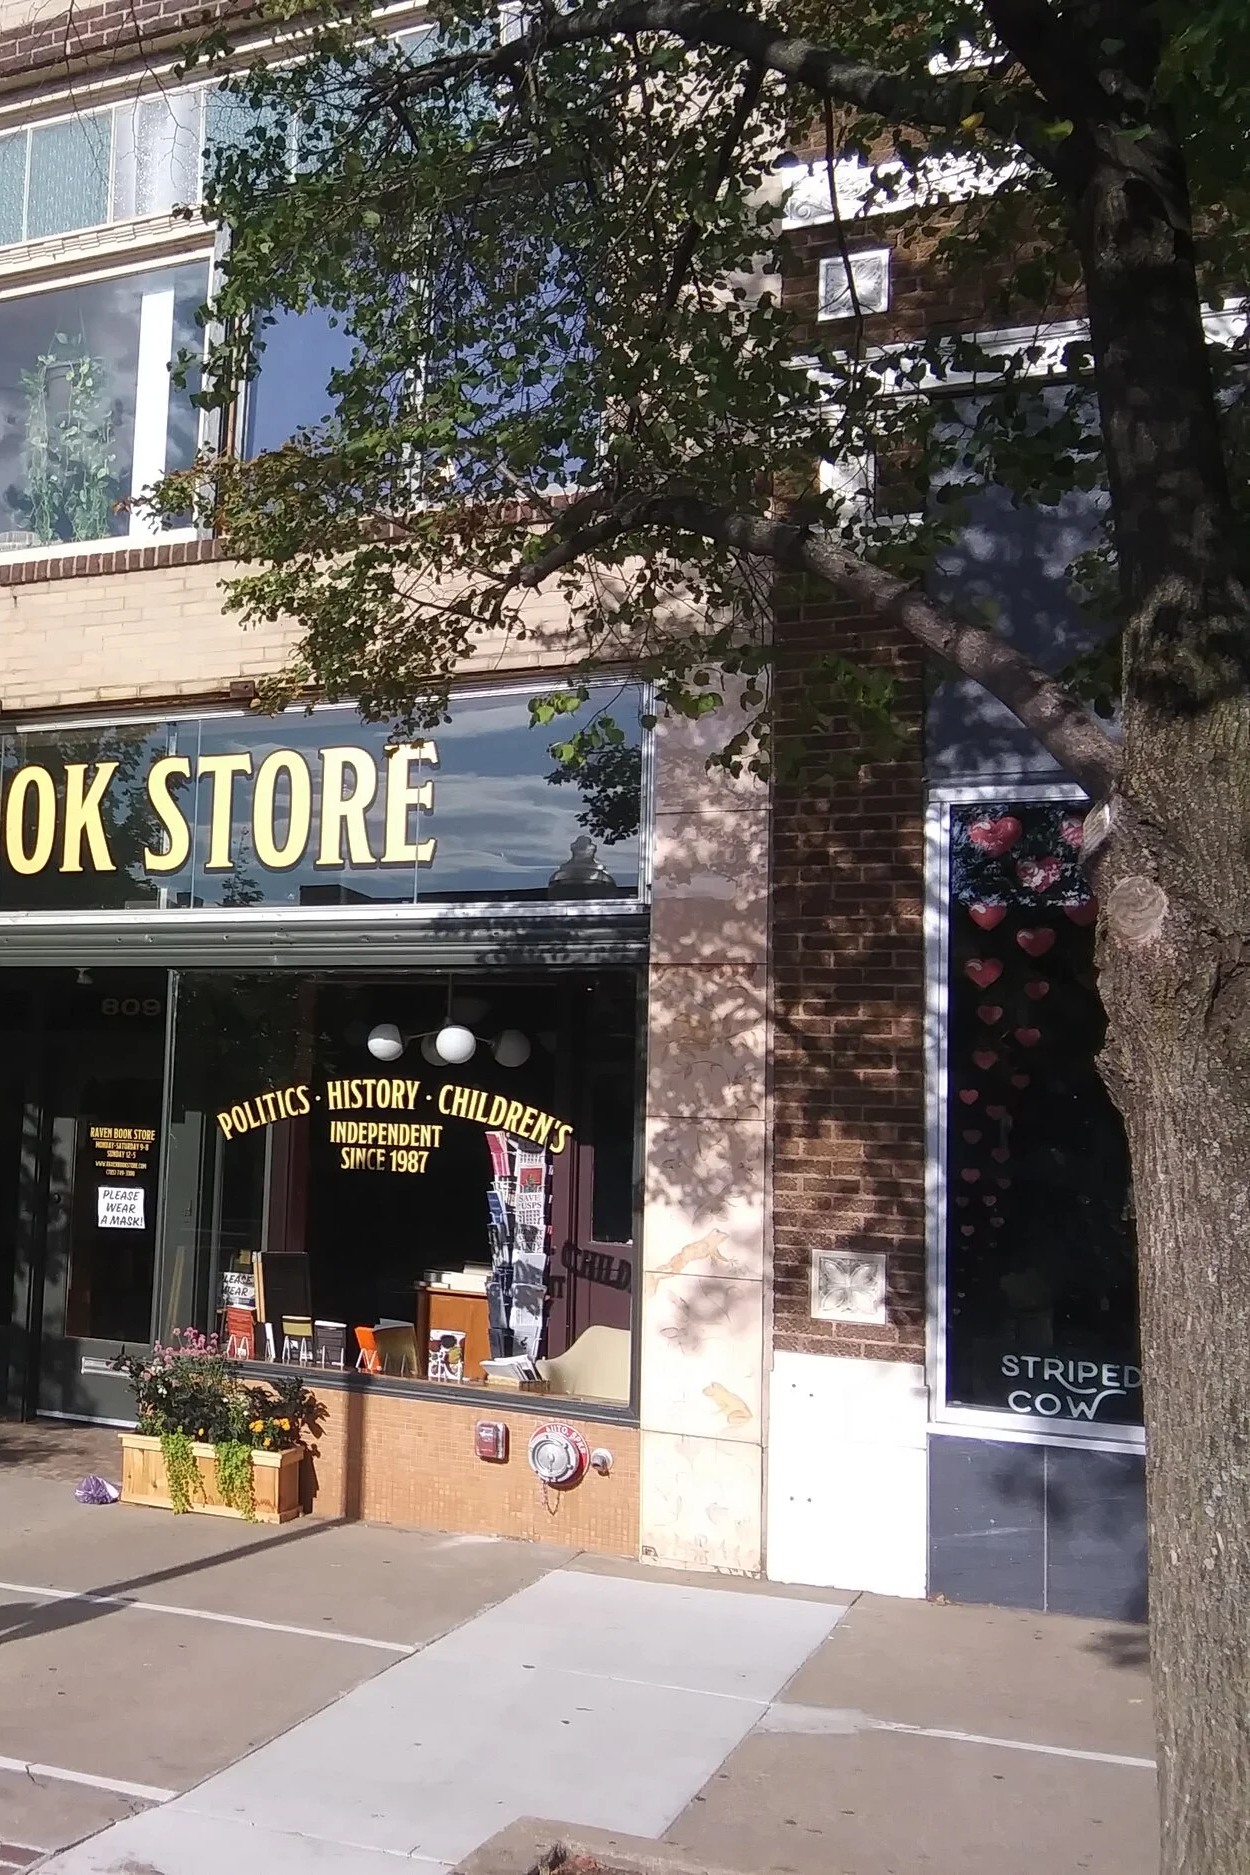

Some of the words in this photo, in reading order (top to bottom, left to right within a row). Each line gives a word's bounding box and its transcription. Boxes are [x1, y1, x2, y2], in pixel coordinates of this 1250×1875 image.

[143, 740, 440, 874] STORE
[101, 997, 162, 1016] 809
[216, 1084, 310, 1141] POLITICS
[327, 1078, 421, 1110] HISTORY
[438, 1084, 573, 1155] CHILDREN'S
[90, 1127, 112, 1138] RAVEN
[113, 1128, 132, 1139] BOOK
[133, 1129, 156, 1141] STORE
[329, 1121, 443, 1148] INDEPENDENT
[340, 1147, 385, 1171] SINCE
[390, 1149, 430, 1173] 1987
[102, 1189, 140, 1201] PLEASE
[519, 1194, 539, 1203] SAVE
[106, 1203, 136, 1213] WEAR
[100, 1215, 108, 1224] A
[109, 1215, 143, 1226] MASK!
[222, 1273, 253, 1285] LEASE
[1001, 1354, 1143, 1394] STRIPED
[1007, 1389, 1127, 1420] COW
